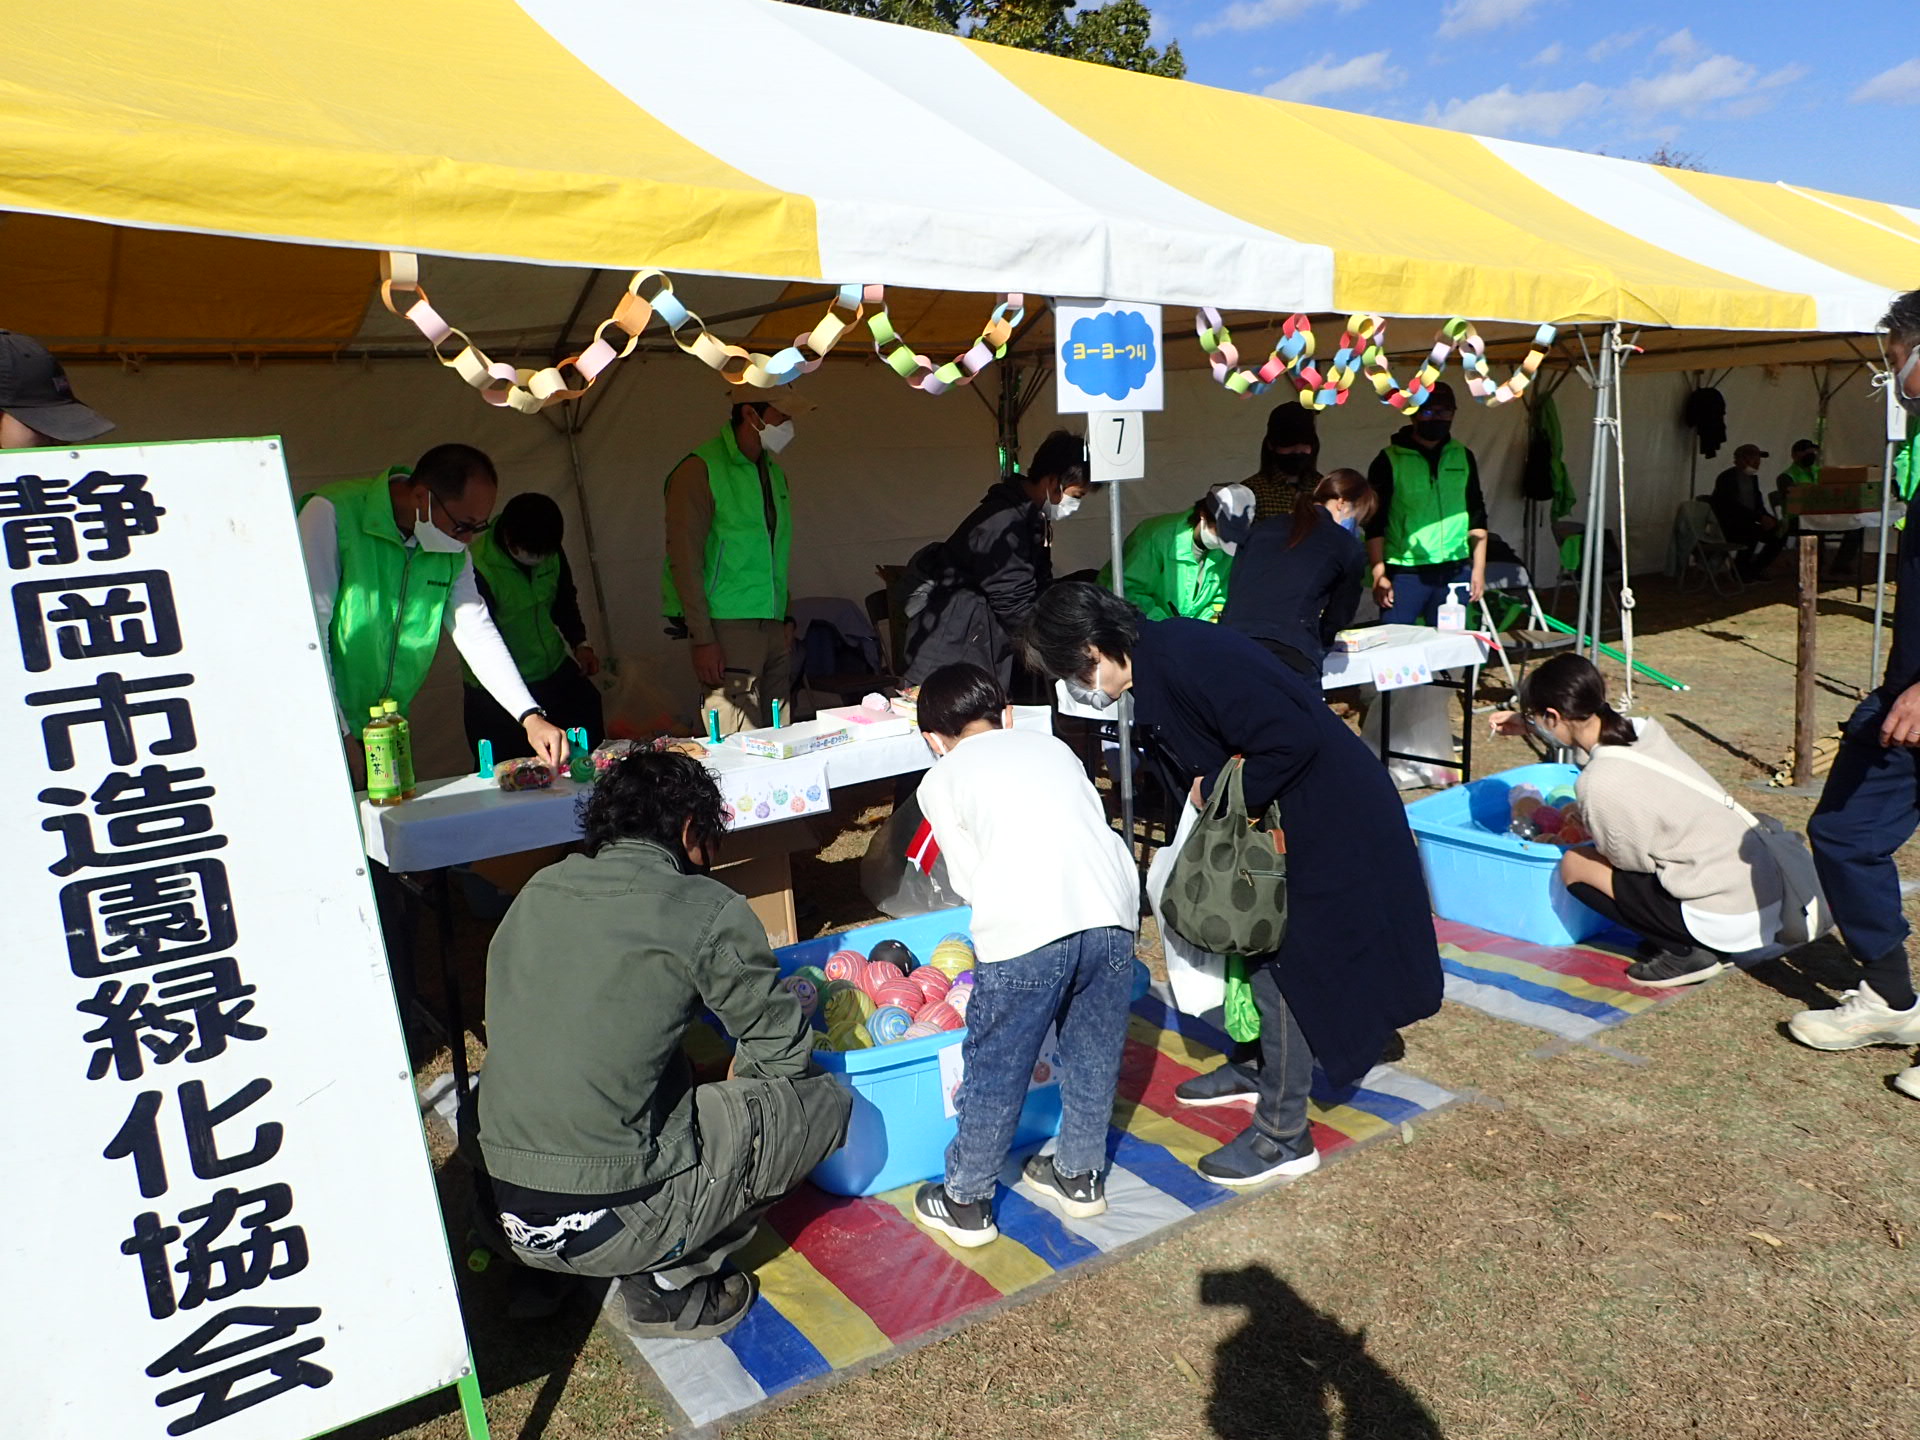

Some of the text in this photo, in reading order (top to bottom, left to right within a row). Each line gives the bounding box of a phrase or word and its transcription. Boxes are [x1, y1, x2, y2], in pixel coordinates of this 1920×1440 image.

[1073, 342, 1147, 361] ヨーヨーつり
[1112, 417, 1125, 455] 7
[0, 470, 333, 1437] 静岡市造園緑化協会
